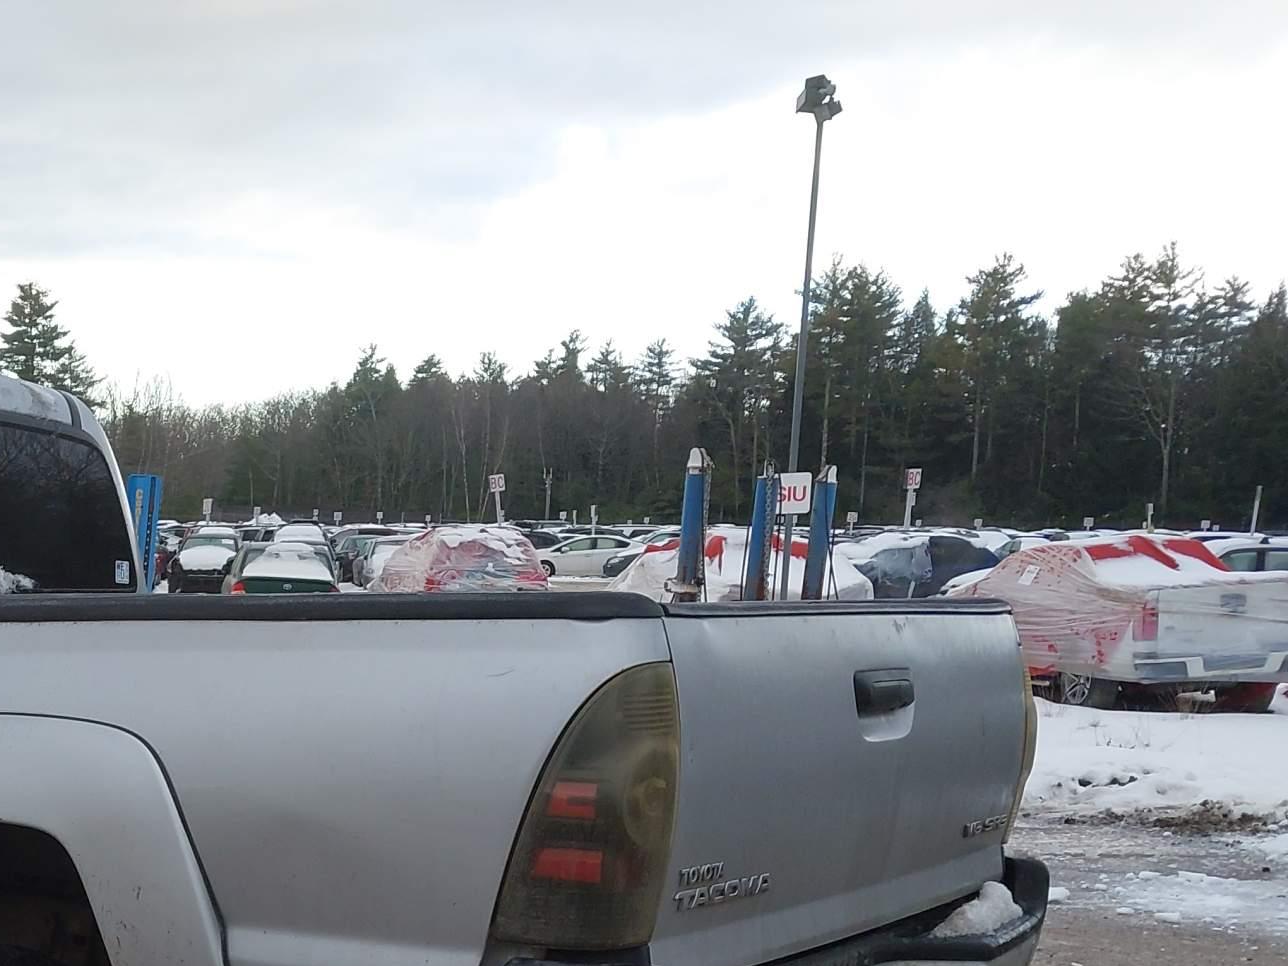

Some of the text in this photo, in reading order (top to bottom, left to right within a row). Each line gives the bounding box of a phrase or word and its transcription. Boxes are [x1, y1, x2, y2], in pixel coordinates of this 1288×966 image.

[490, 475, 505, 490] BC
[776, 485, 807, 502] SIU
[680, 862, 724, 884] TOYOTA
[674, 873, 770, 910] TACOMA
